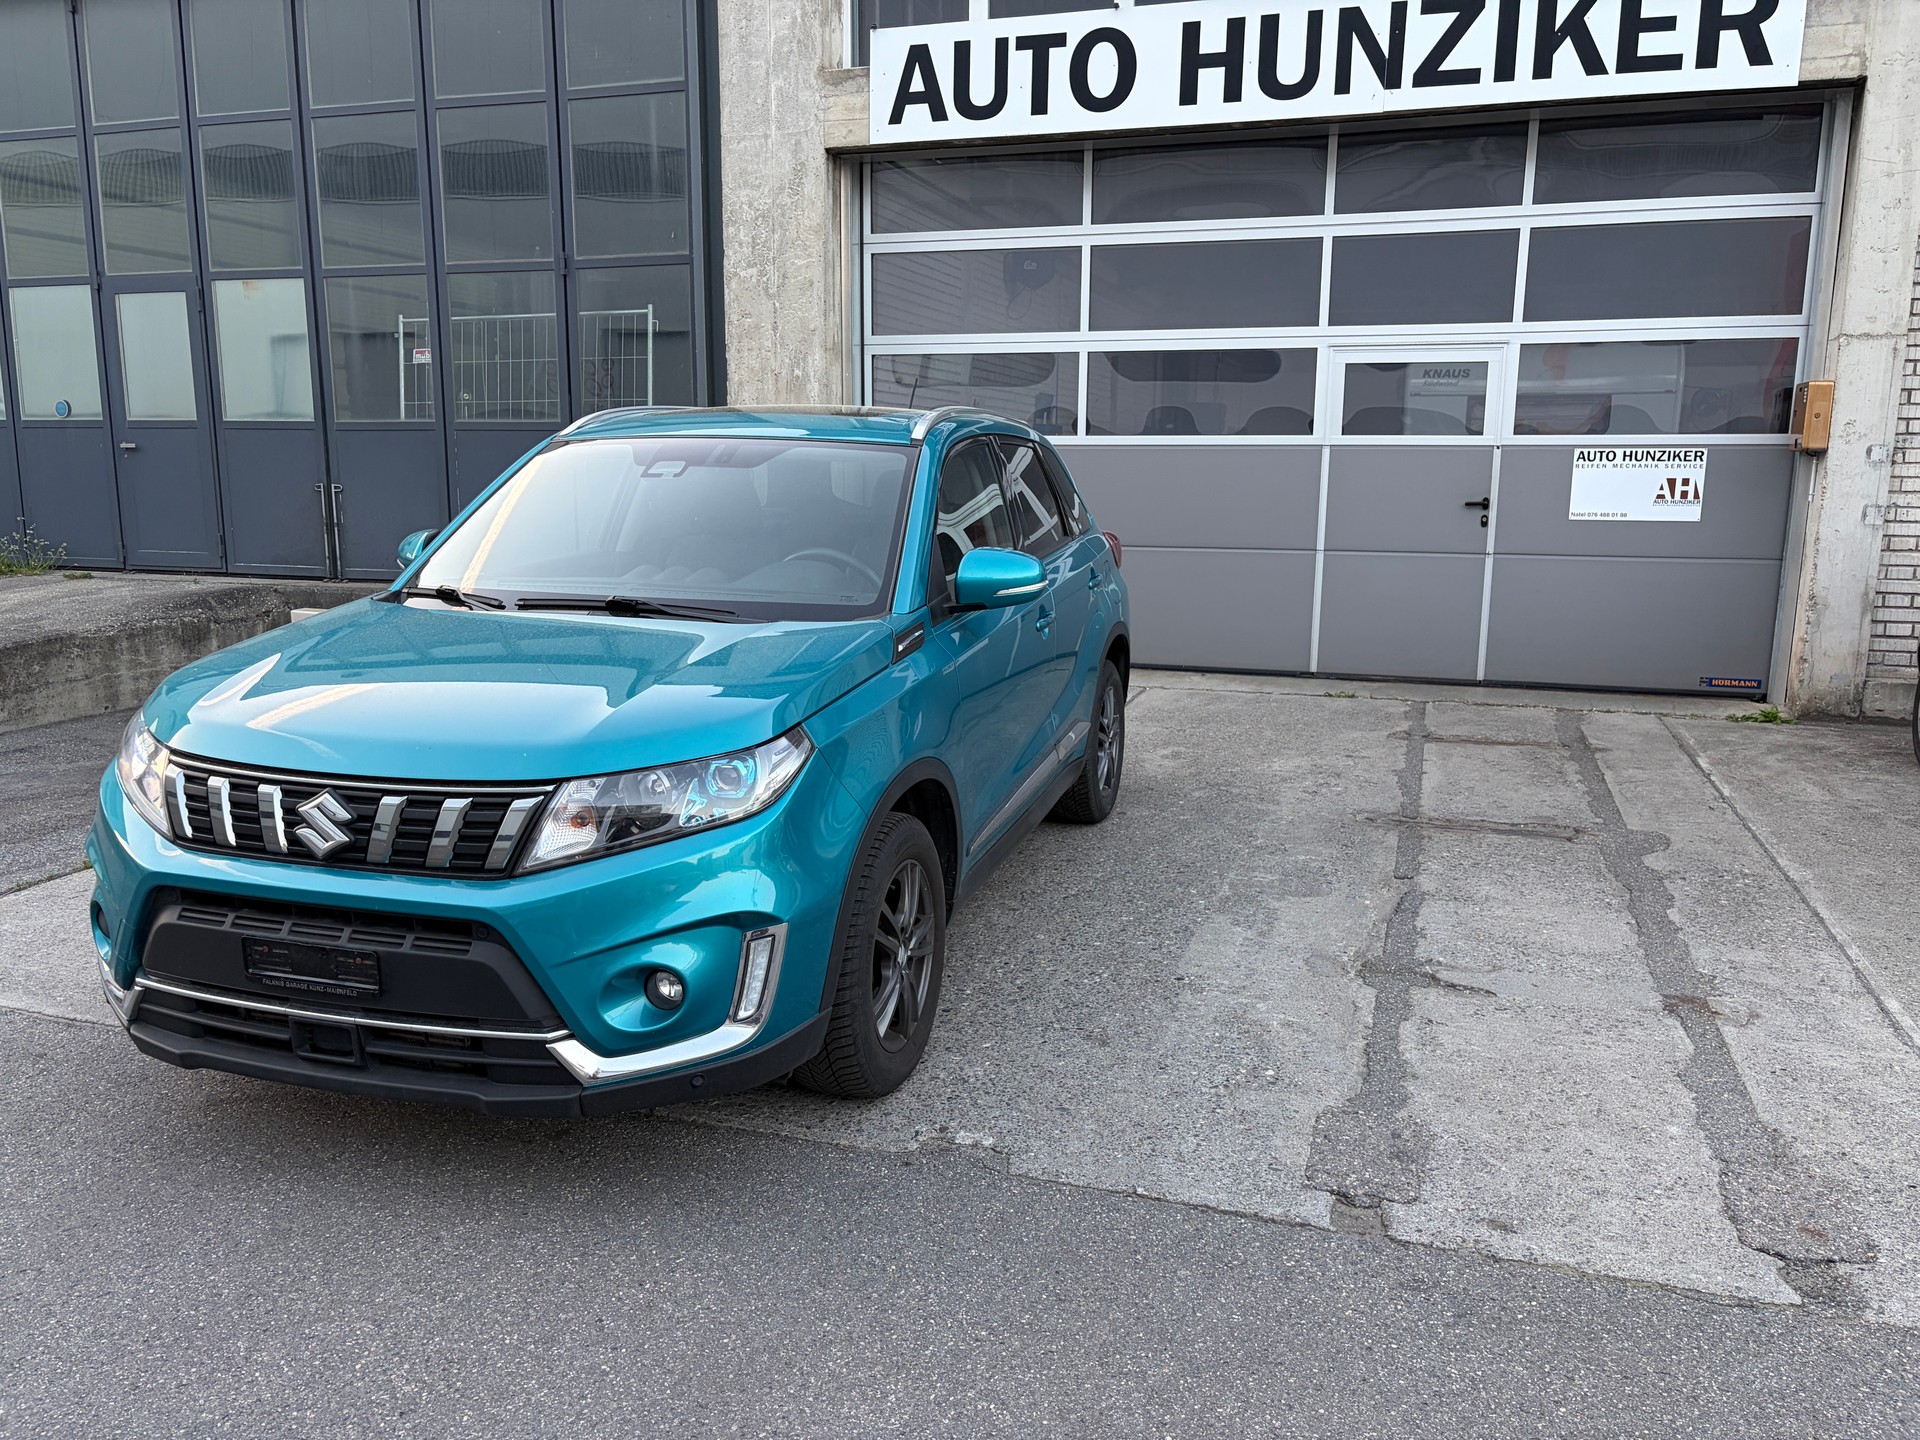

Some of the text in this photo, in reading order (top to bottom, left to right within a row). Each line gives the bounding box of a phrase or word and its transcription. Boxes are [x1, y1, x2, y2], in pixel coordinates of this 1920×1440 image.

[888, 0, 1780, 125] AUTO HUNZIKER
[1422, 368, 1471, 378] KNAUS
[1576, 450, 1705, 462] AUTO HUNZIKER
[285, 981, 308, 990] GARAGE
